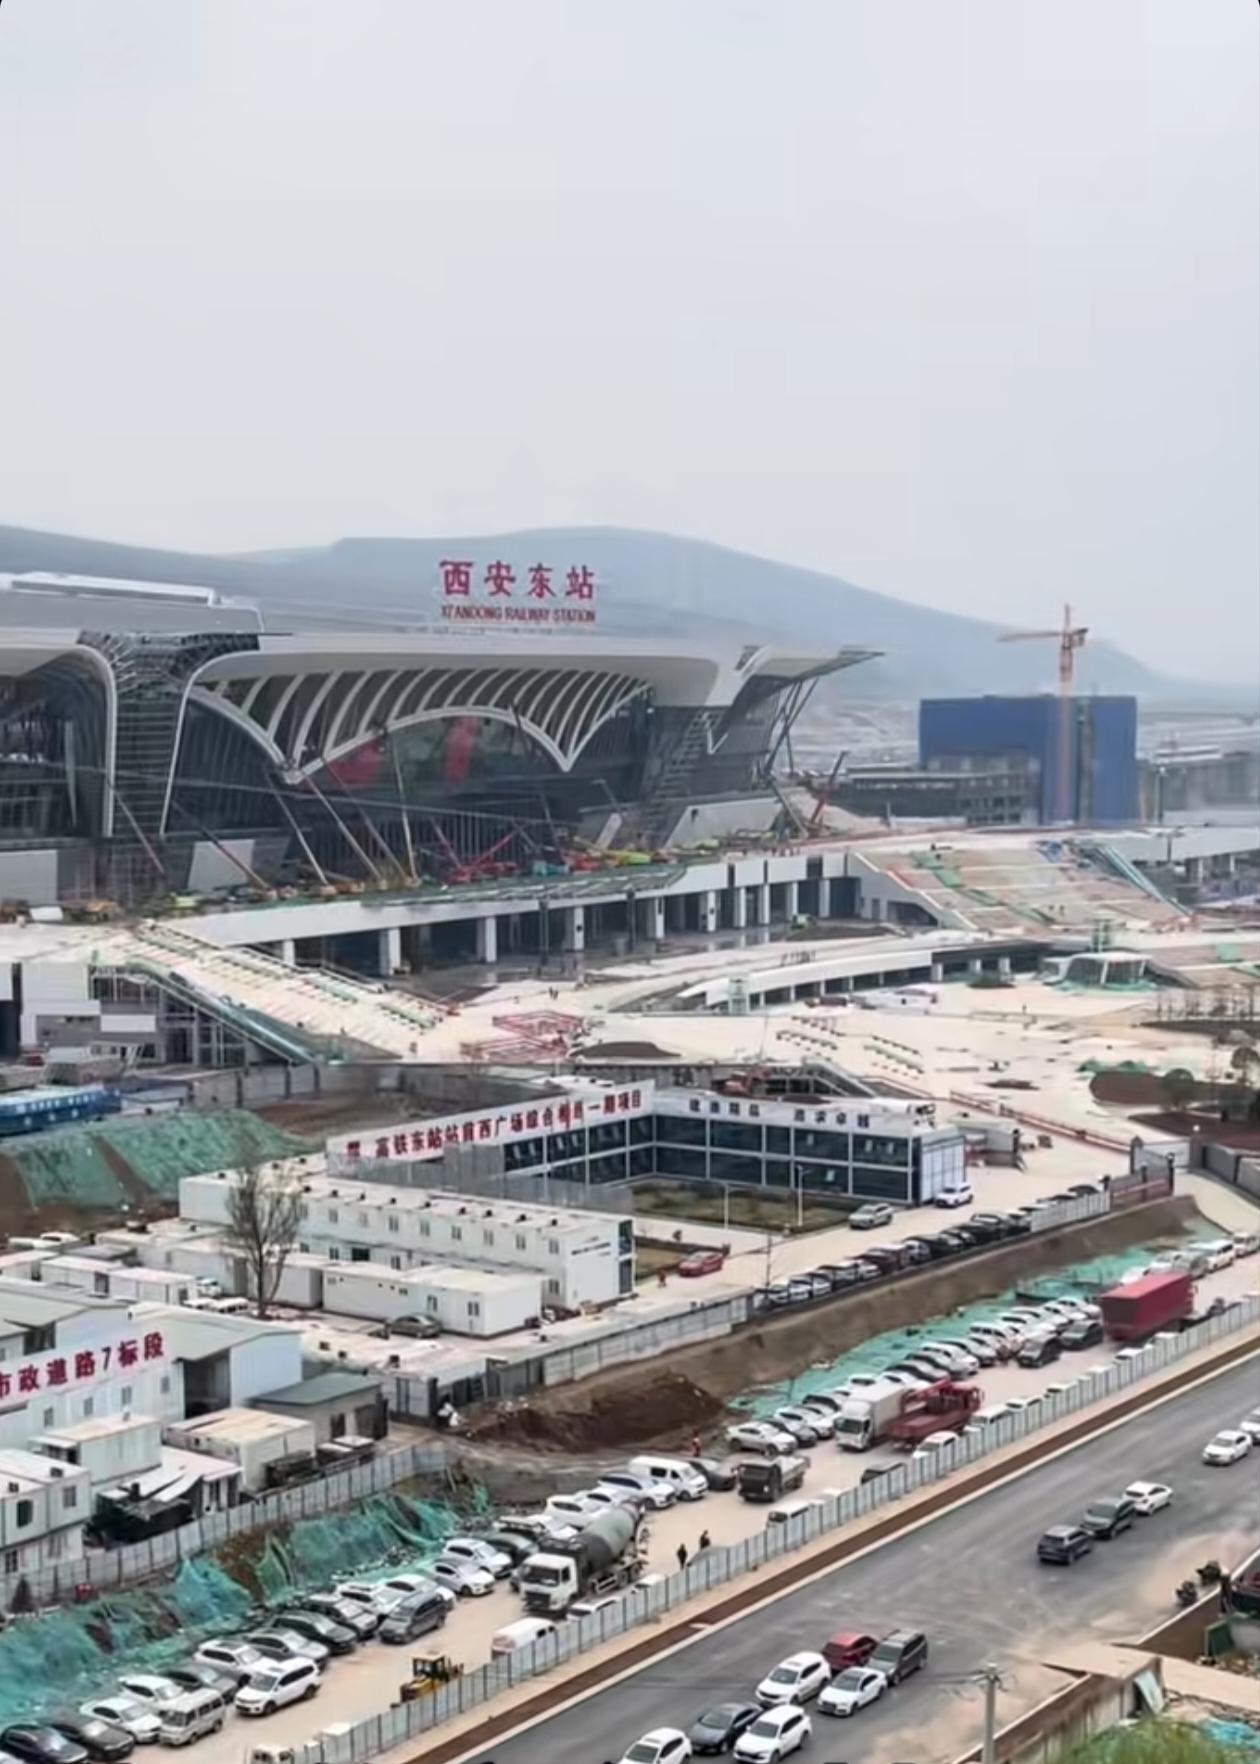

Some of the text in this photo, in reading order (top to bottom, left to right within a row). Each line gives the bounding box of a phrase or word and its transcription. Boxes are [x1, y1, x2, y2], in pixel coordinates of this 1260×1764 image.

[439, 559, 595, 599] 西安东站
[505, 606, 549, 622] RAILWAY
[553, 608, 595, 622] STATION
